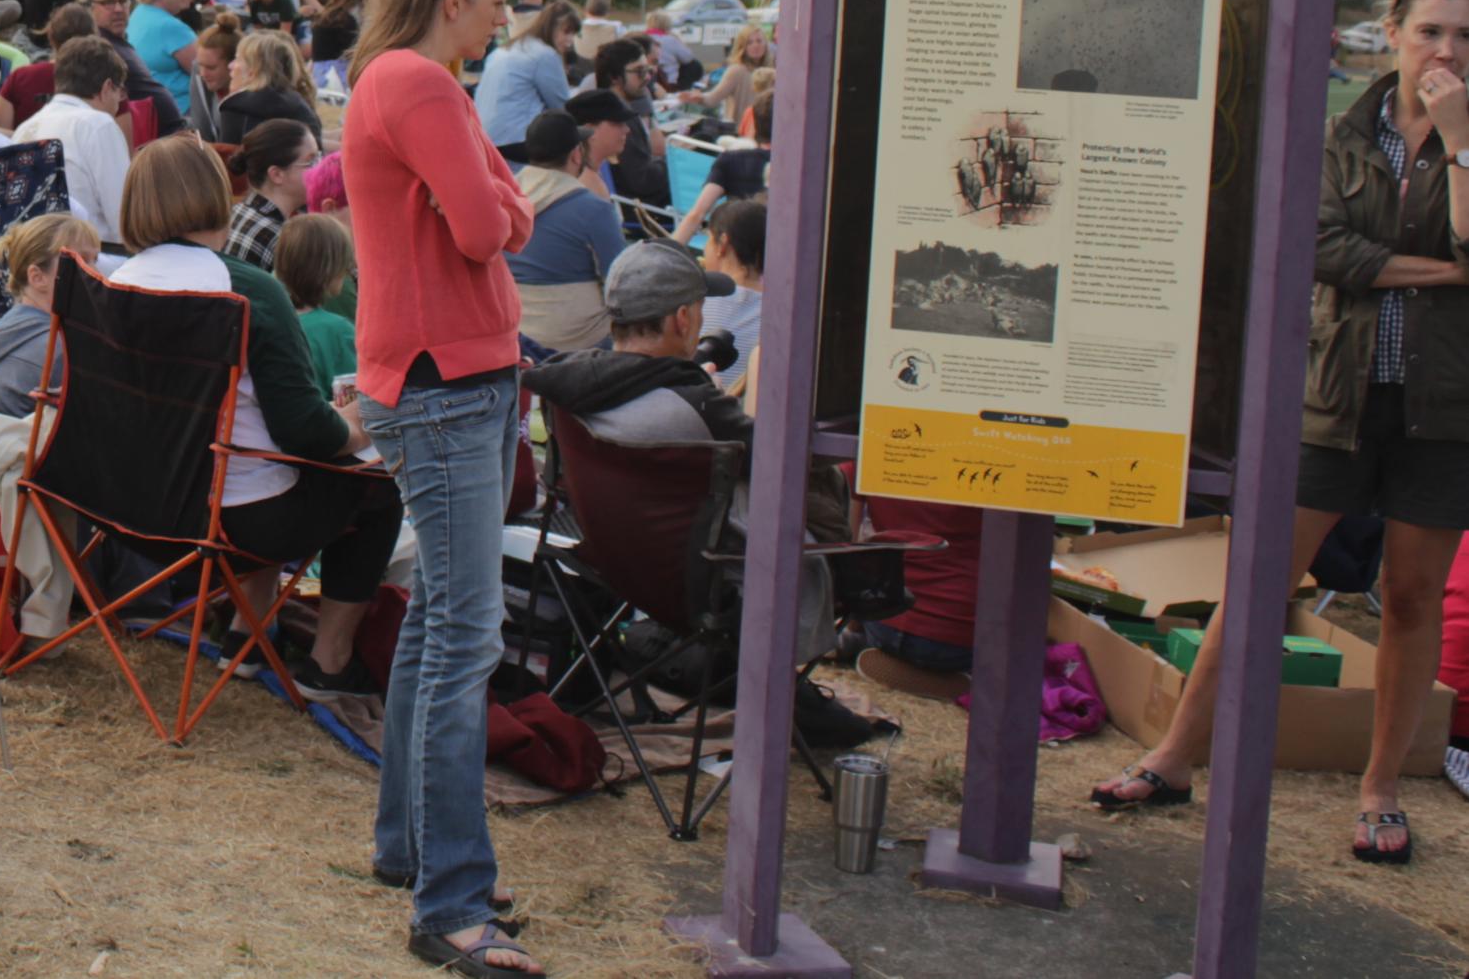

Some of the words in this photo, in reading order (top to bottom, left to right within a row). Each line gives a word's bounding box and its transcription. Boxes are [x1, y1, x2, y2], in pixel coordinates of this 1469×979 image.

[1082, 143, 1121, 153] Protecting
[1138, 147, 1167, 155] World's
[1082, 154, 1109, 162] Largest
[1140, 158, 1167, 166] Colony
[972, 428, 1000, 437] Swift
[1003, 431, 1049, 446] Watching
